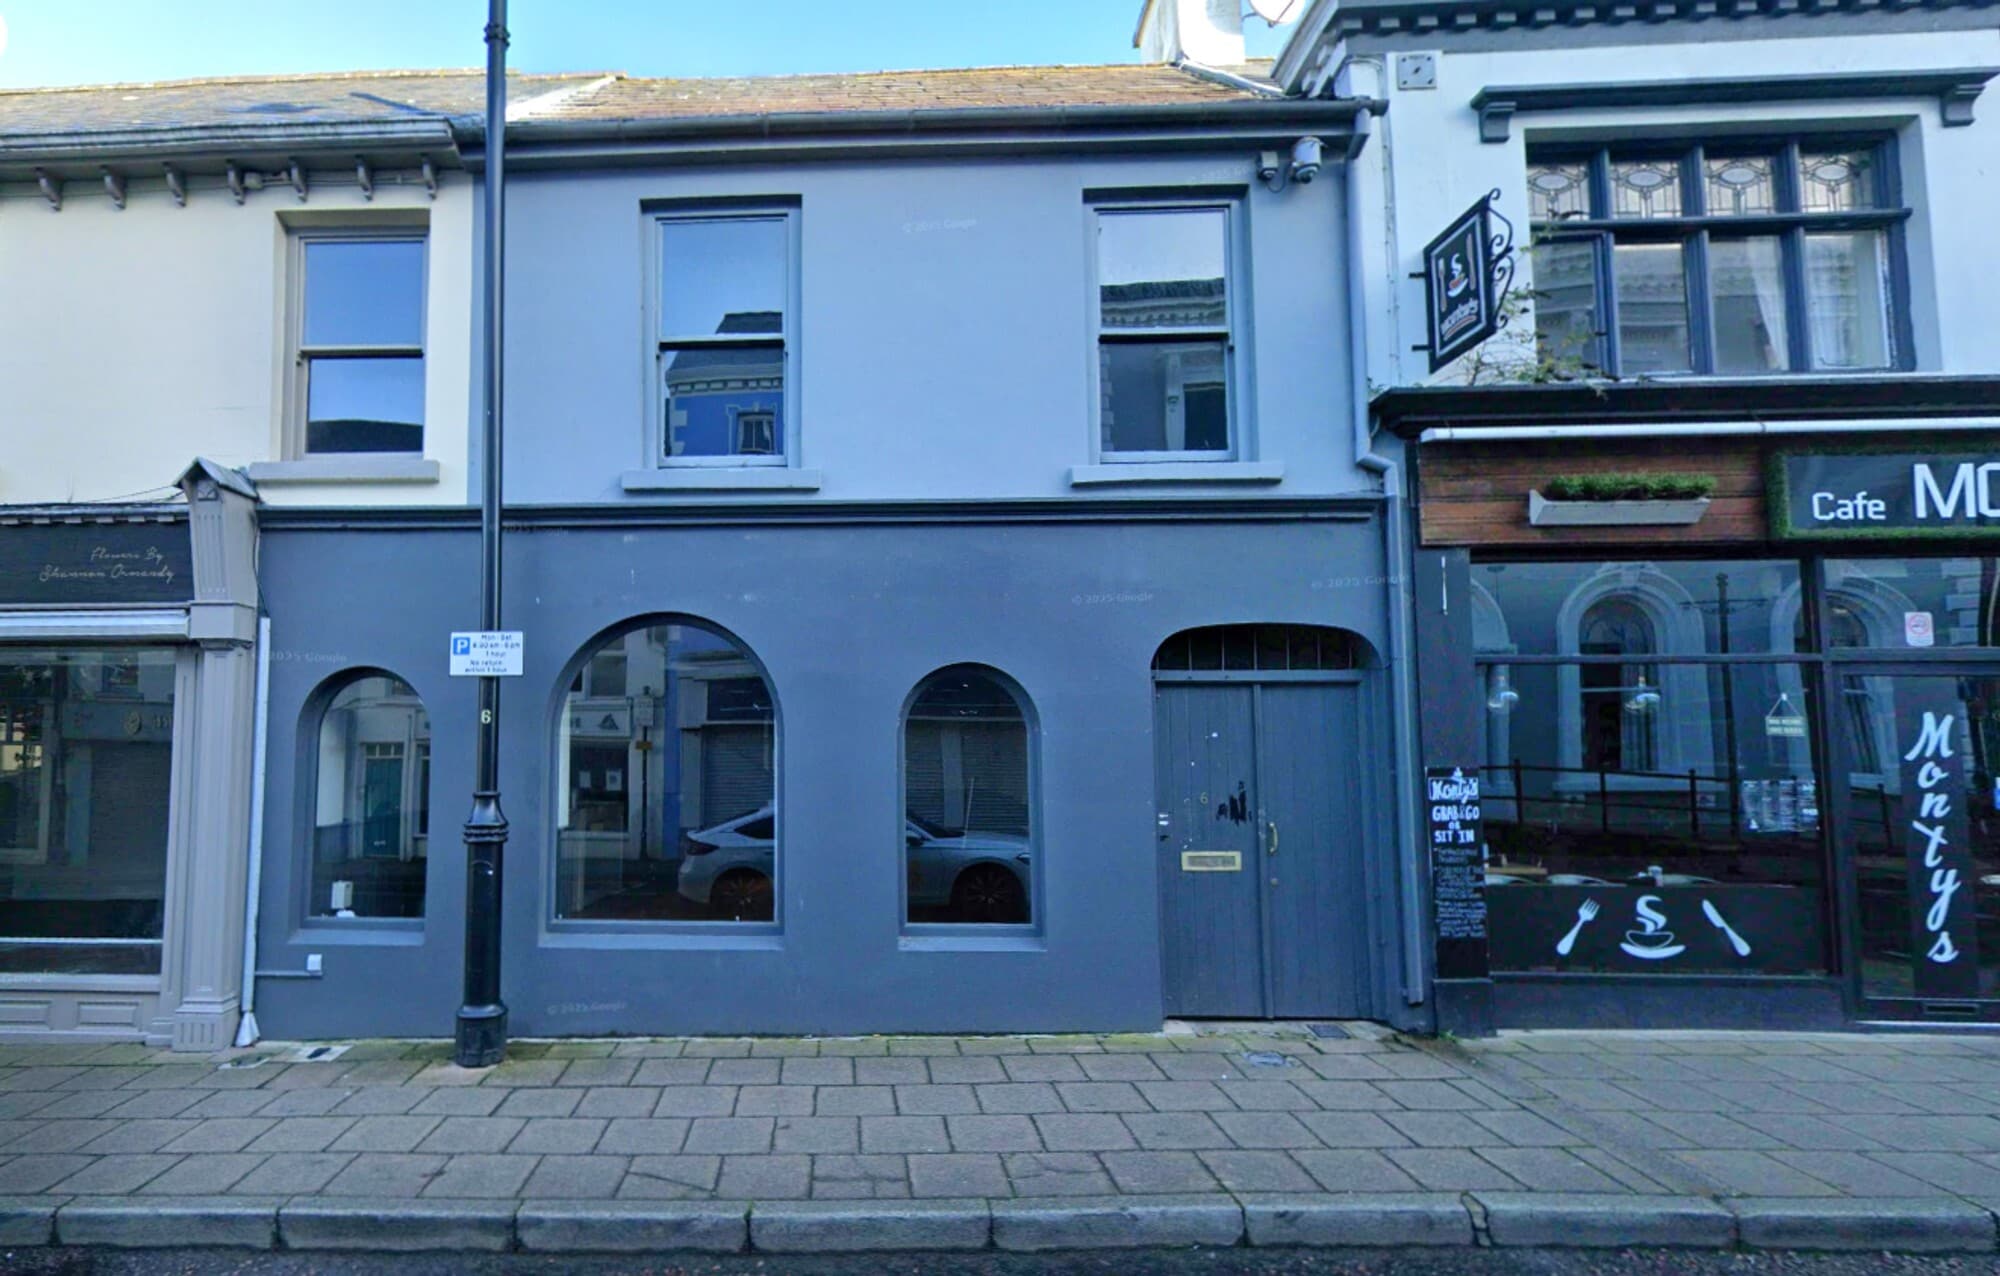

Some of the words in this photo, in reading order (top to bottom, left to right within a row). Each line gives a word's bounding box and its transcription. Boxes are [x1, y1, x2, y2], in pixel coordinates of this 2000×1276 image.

[1812, 491, 1887, 520] Cafe
[90, 546, 140, 562] Flowers
[144, 546, 163, 565] By
[39, 564, 105, 582] Shannon
[481, 709, 492, 724] 6
[1200, 791, 1209, 804] 6
[1432, 805, 1458, 821] GRAB
[1466, 804, 1480, 820] GO
[1434, 830, 1454, 843] SIT
[1457, 829, 1475, 843] IN
[1904, 711, 1961, 962] Montys
